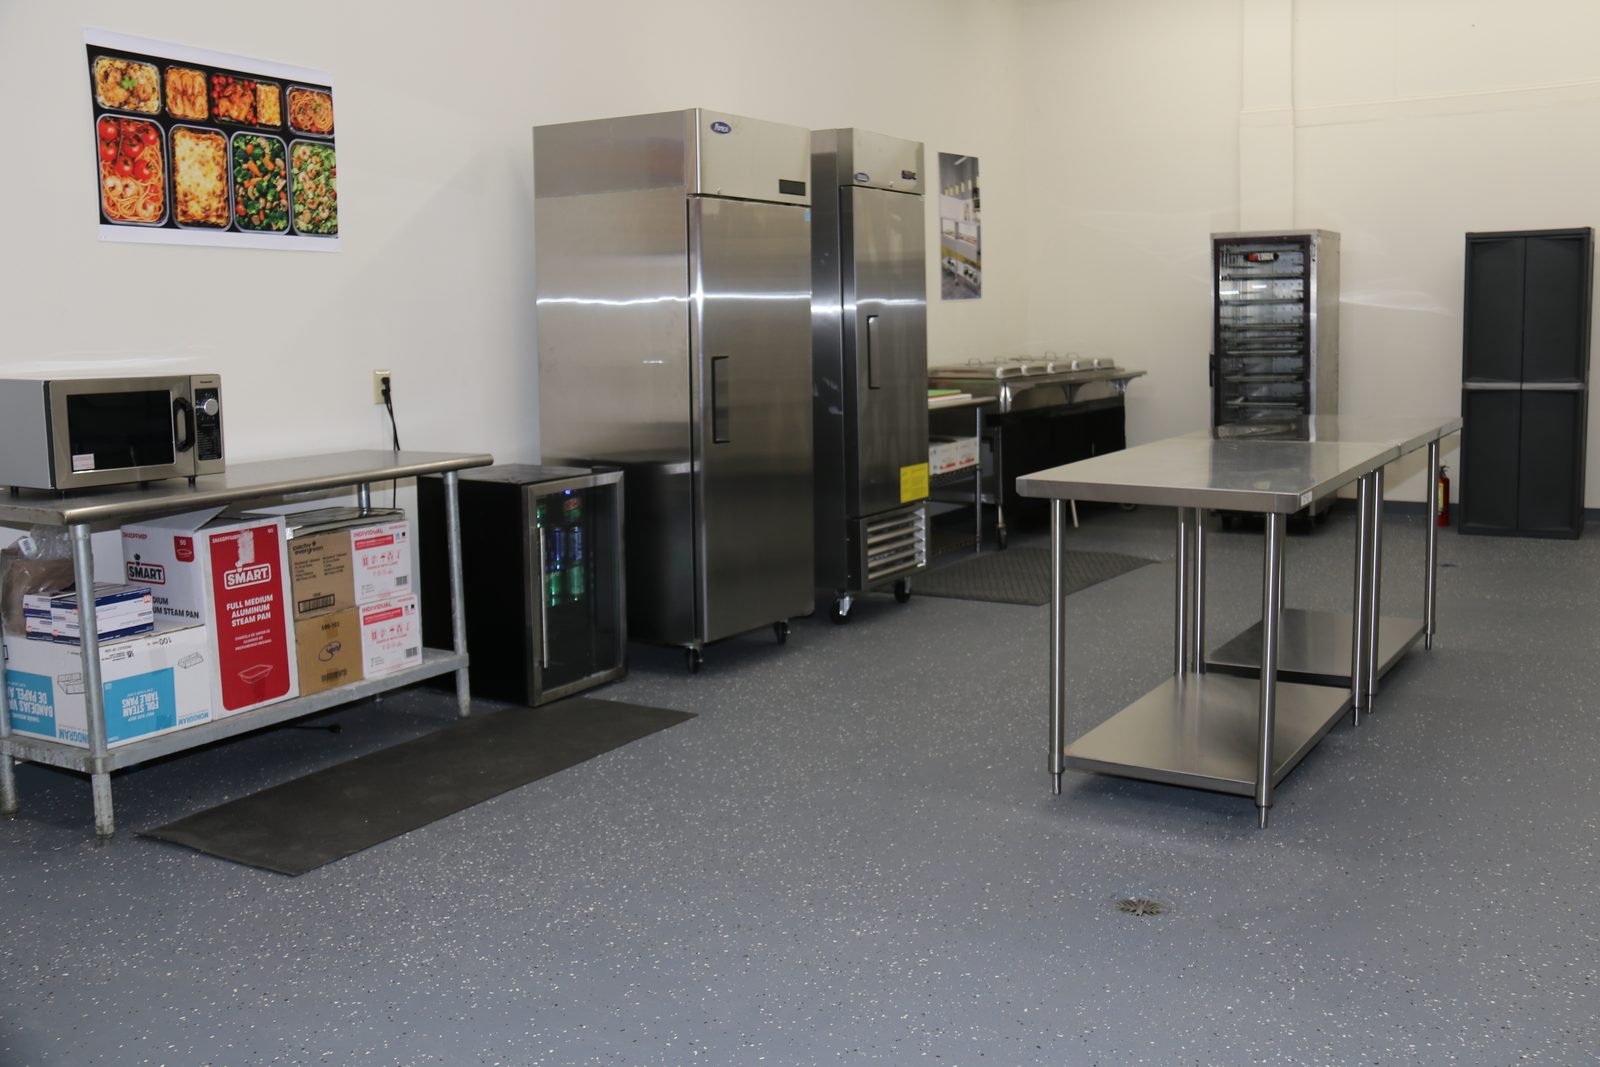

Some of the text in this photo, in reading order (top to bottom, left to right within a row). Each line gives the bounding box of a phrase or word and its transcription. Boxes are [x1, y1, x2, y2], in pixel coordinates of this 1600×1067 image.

[128, 564, 163, 581] SMART
[227, 567, 268, 587] SMART
[153, 596, 169, 605] DIUM
[226, 594, 274, 611] FULL MEDIUM
[164, 607, 184, 617] STEAM
[185, 609, 200, 619] PAN
[231, 604, 271, 619] ALUMINUM
[231, 611, 272, 628] STEAM PAN
[158, 636, 172, 645] 100
[15, 686, 37, 703] PAPEL
[37, 691, 48, 705] DE
[121, 695, 139, 708] PANS
[139, 691, 159, 703] TABLE
[18, 699, 54, 718] BANDEJAS
[122, 704, 145, 717] STEAM
[58, 727, 89, 744] NOGRAM
